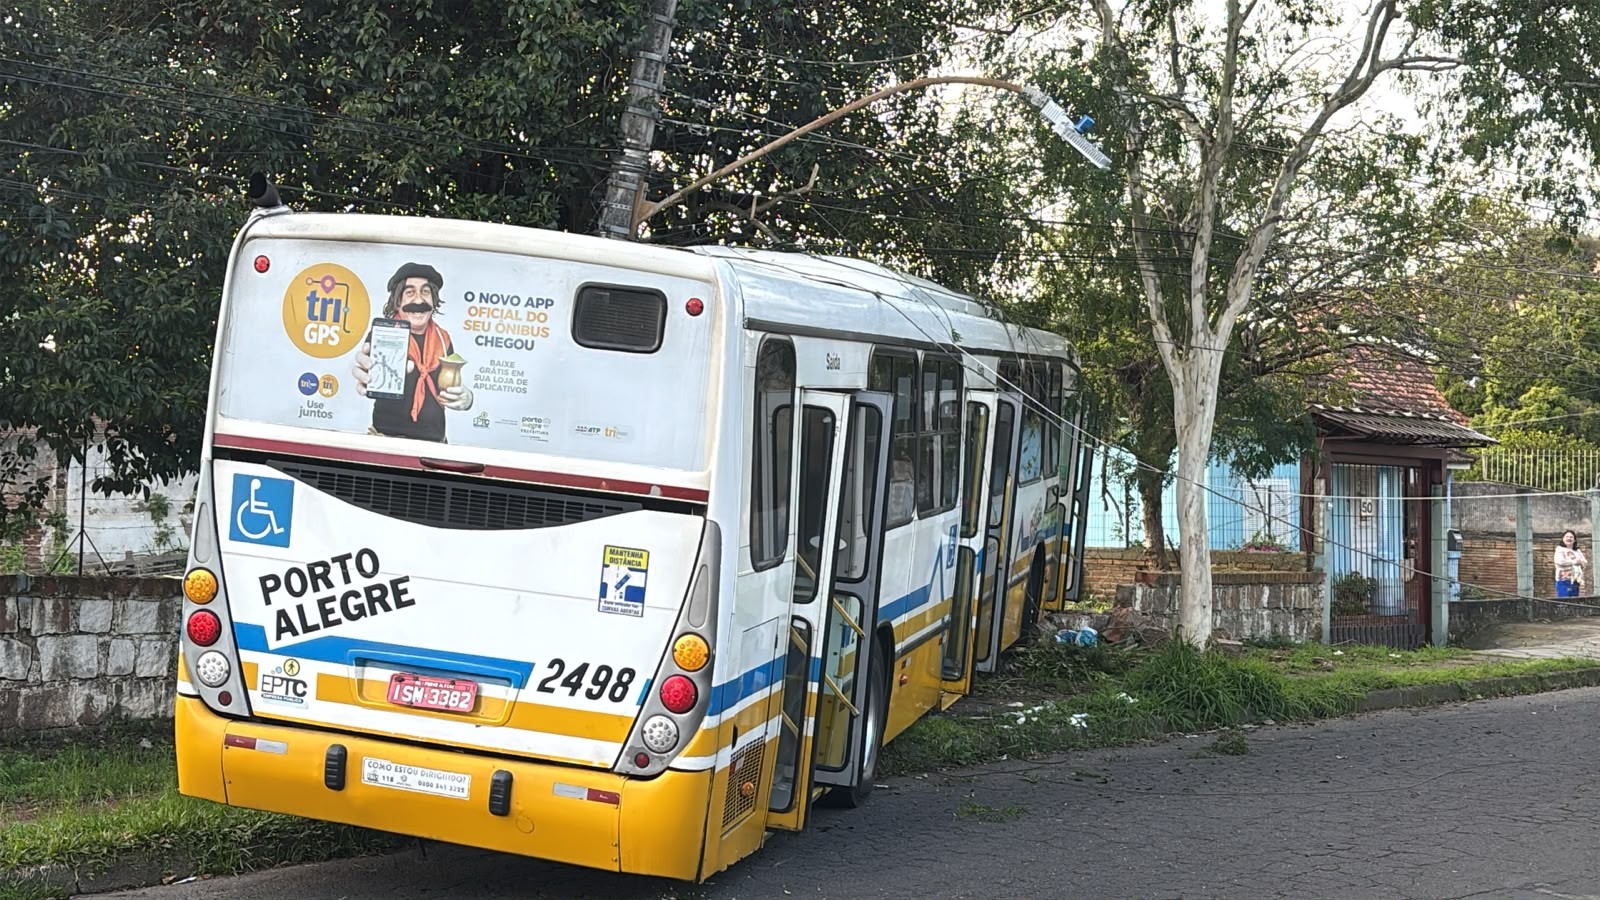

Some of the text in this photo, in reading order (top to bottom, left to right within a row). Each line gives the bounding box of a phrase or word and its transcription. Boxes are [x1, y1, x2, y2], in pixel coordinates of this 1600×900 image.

[306, 290, 342, 323] tri
[464, 291, 555, 309] O NOVO APP
[467, 305, 548, 323] OFICIAL DO
[304, 322, 341, 346] GPS
[463, 319, 550, 338] SEU ÔNIBUS
[474, 334, 535, 351] CHEGOU
[479, 366, 524, 377] GRÁTIS EM
[490, 359, 515, 369] BAIXE
[473, 374, 528, 386] SUA LOJA DE
[473, 382, 528, 394] APLICATIVOS
[306, 399, 325, 409] Use
[298, 405, 334, 419] juntos
[1361, 501, 1373, 514] 50
[609, 548, 644, 559] MANTENHA
[609, 556, 642, 567] DISTÂNCIA
[258, 547, 380, 606] PORTO
[275, 575, 416, 641] ALEGRE
[261, 674, 308, 698] EPTC
[537, 658, 636, 703] 2498
[394, 765, 419, 776] ESTOU
